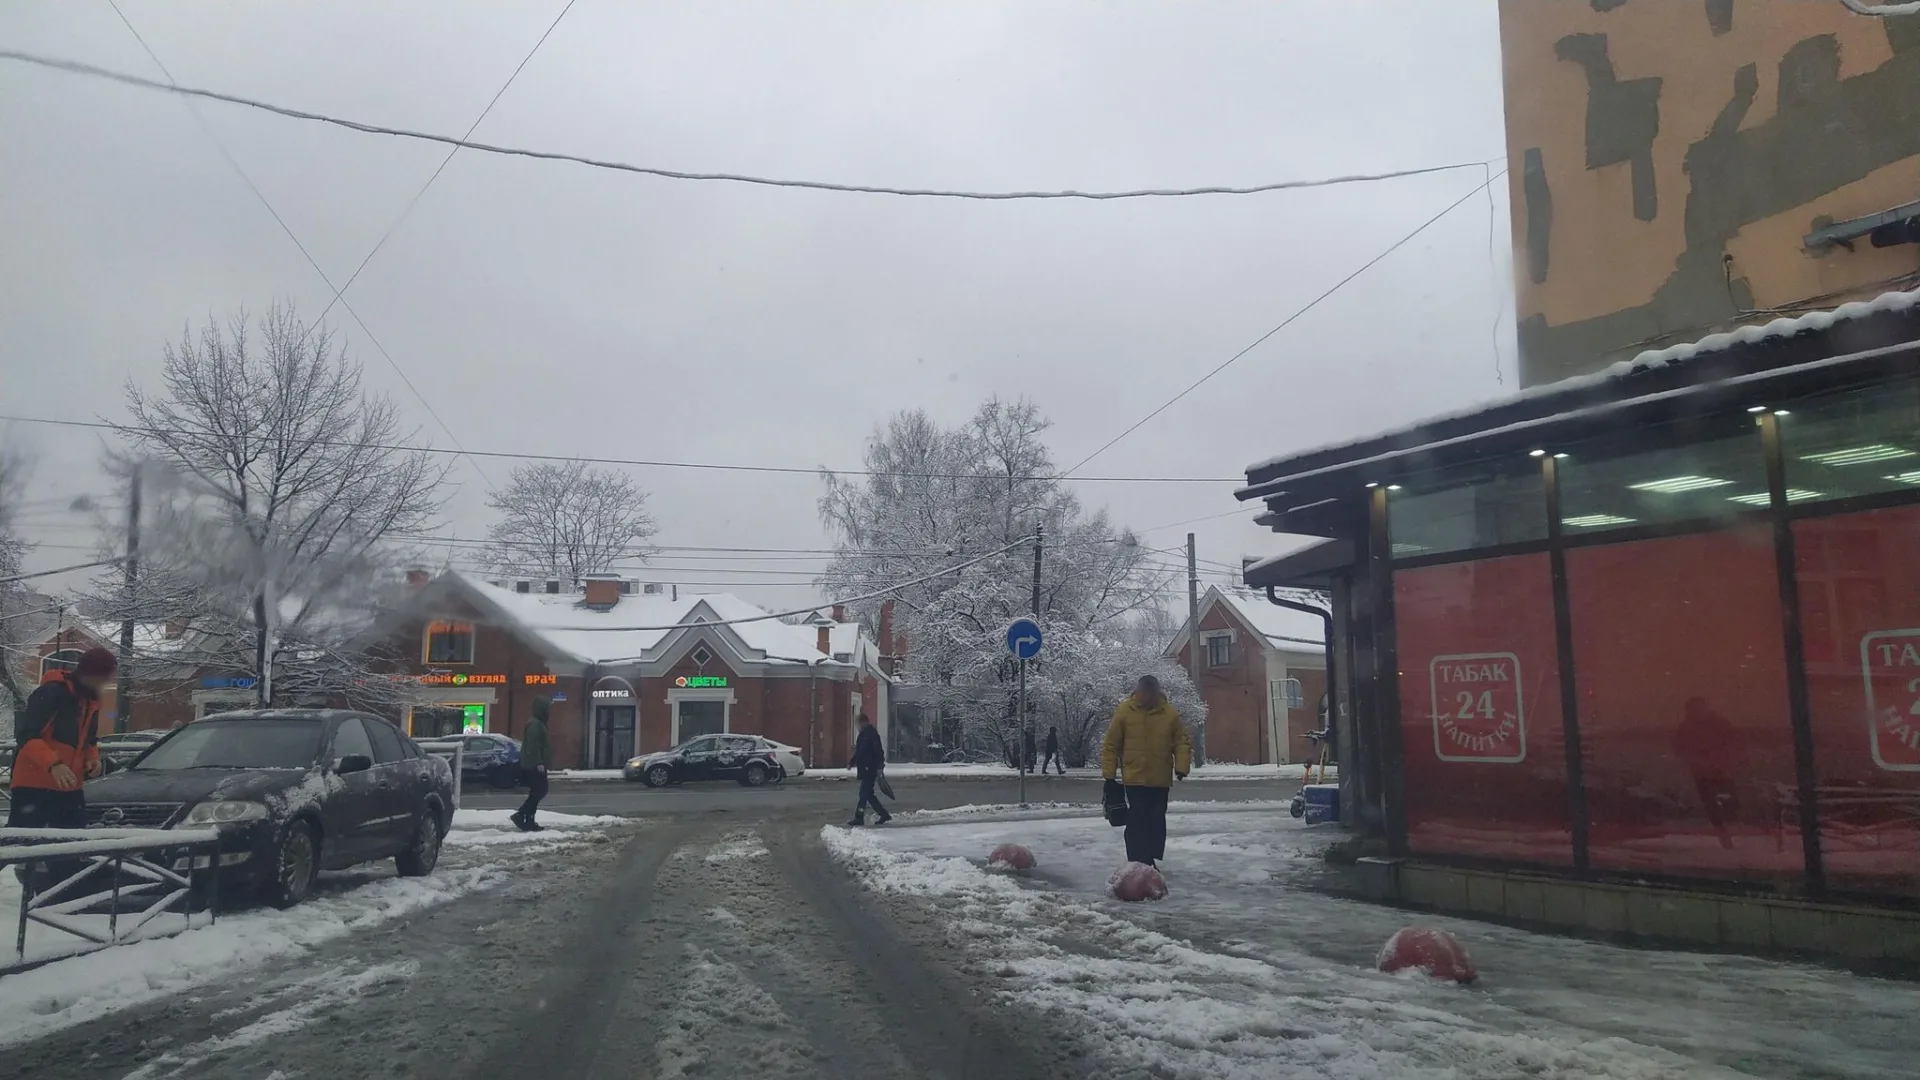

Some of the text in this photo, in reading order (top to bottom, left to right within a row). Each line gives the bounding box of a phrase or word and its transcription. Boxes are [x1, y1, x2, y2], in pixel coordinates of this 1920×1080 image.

[687, 676, 727, 688] ЦВЕТЫ
[1440, 663, 1508, 683] ТАБАК
[592, 689, 629, 698] оптика
[1456, 690, 1496, 719] 24
[1441, 711, 1517, 752] НАПИТКИ
